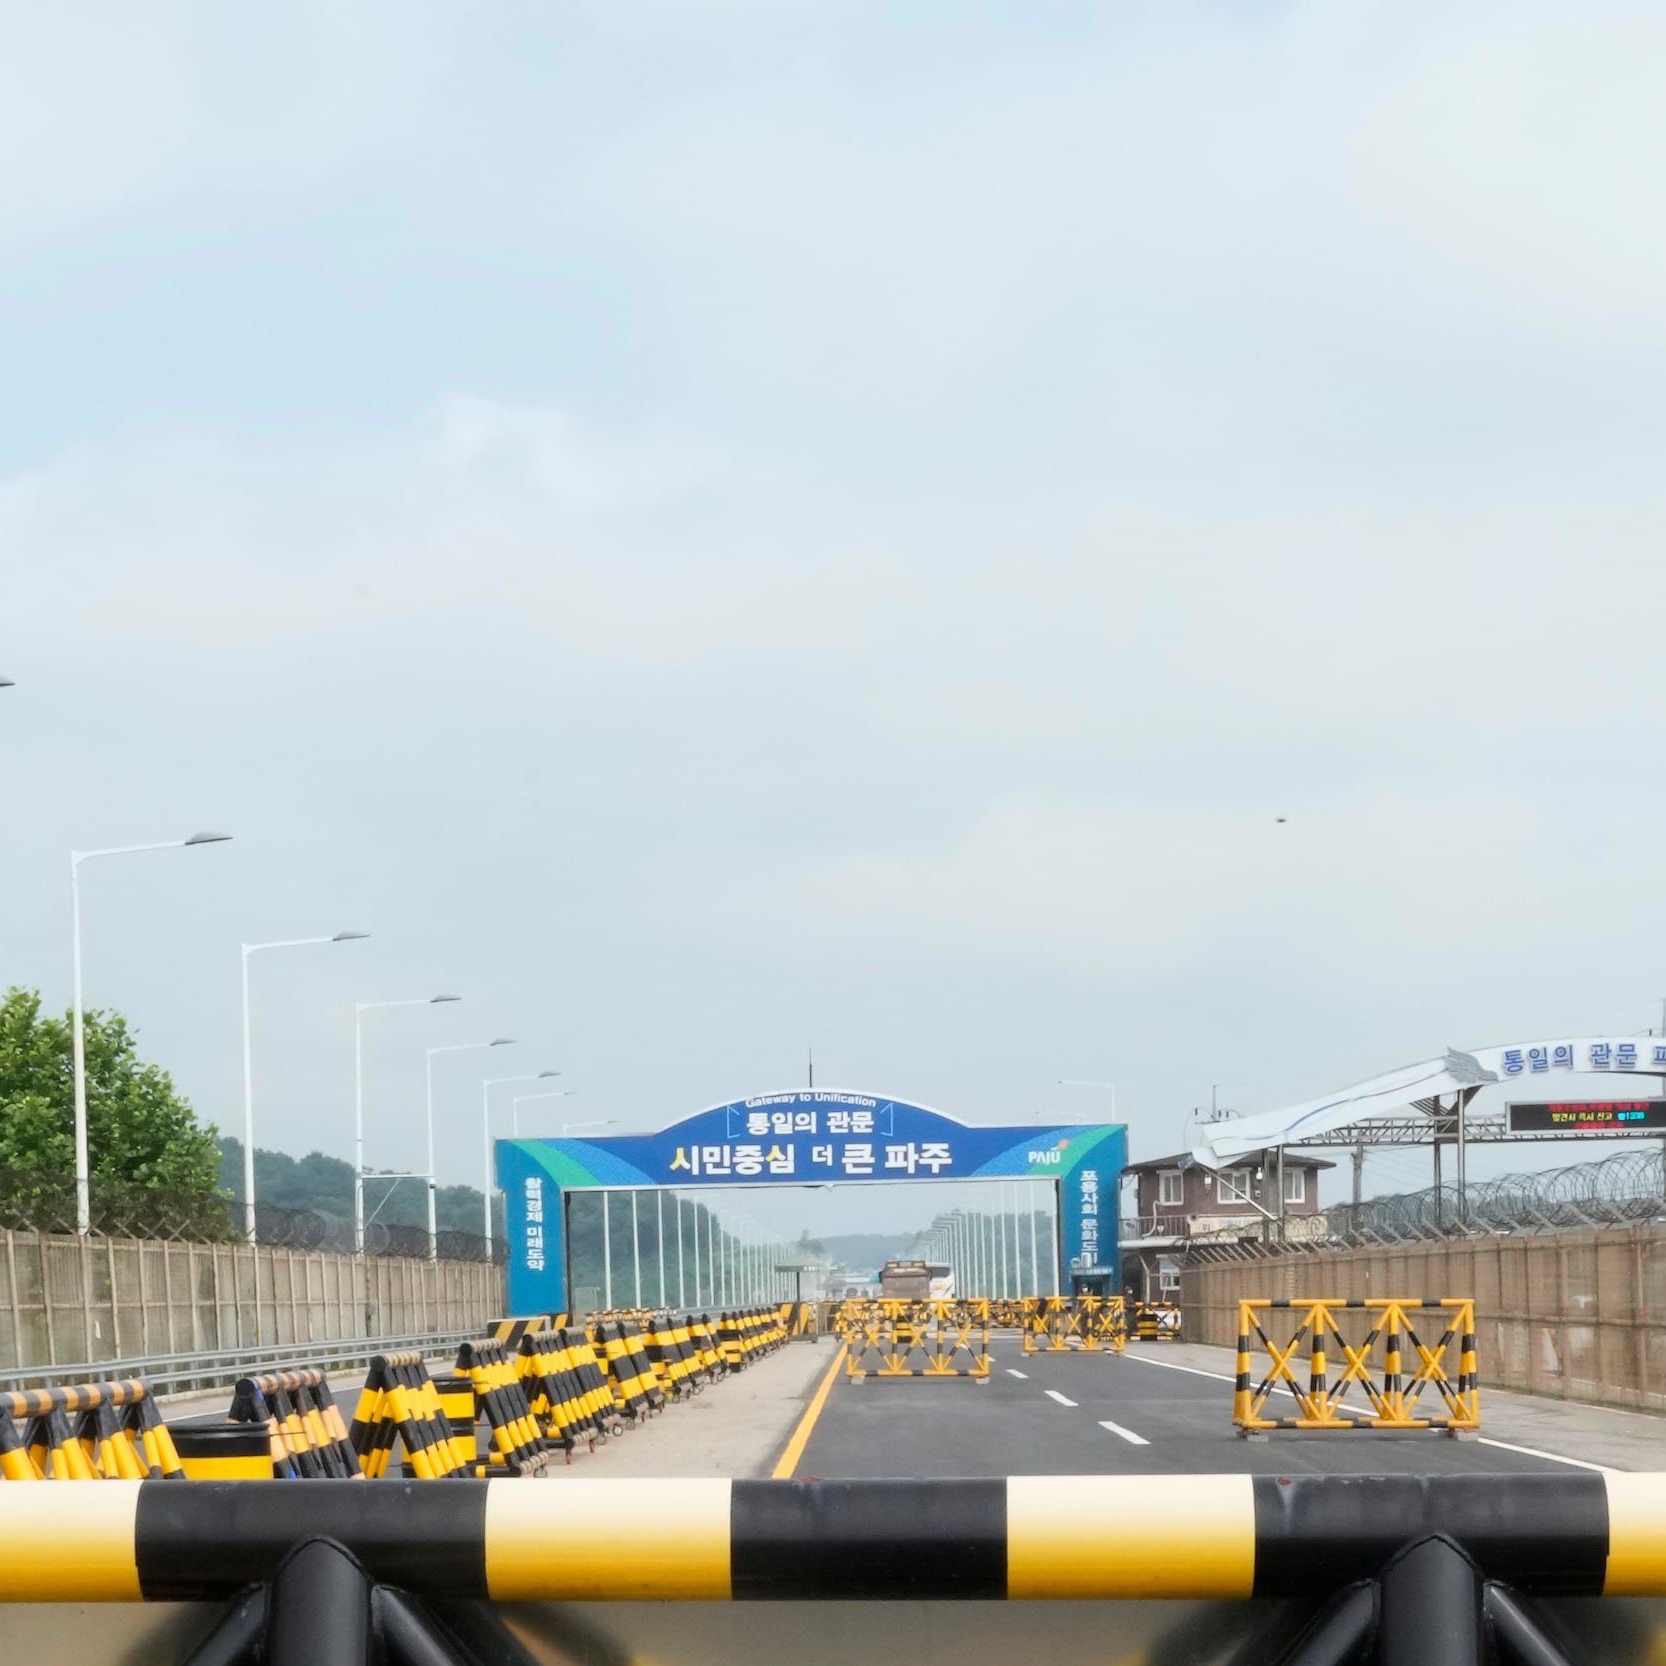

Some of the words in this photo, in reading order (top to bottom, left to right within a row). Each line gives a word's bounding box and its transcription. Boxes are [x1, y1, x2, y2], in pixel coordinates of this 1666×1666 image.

[1504, 1044, 1574, 1075] 통일의
[1591, 1043, 1637, 1067] 관문
[745, 1093, 795, 1108] Gateway
[799, 1093, 812, 1102] to
[815, 1093, 876, 1108] Unification
[746, 1112, 817, 1136] 통일의
[826, 1111, 875, 1135] 관문
[669, 1143, 796, 1176] 시민중심
[812, 1144, 833, 1167] 더
[841, 1143, 876, 1174] 큰
[884, 1142, 953, 1175] 파주
[1028, 1151, 1061, 1164] PAJU
[526, 1227, 545, 1270] 미래도약
